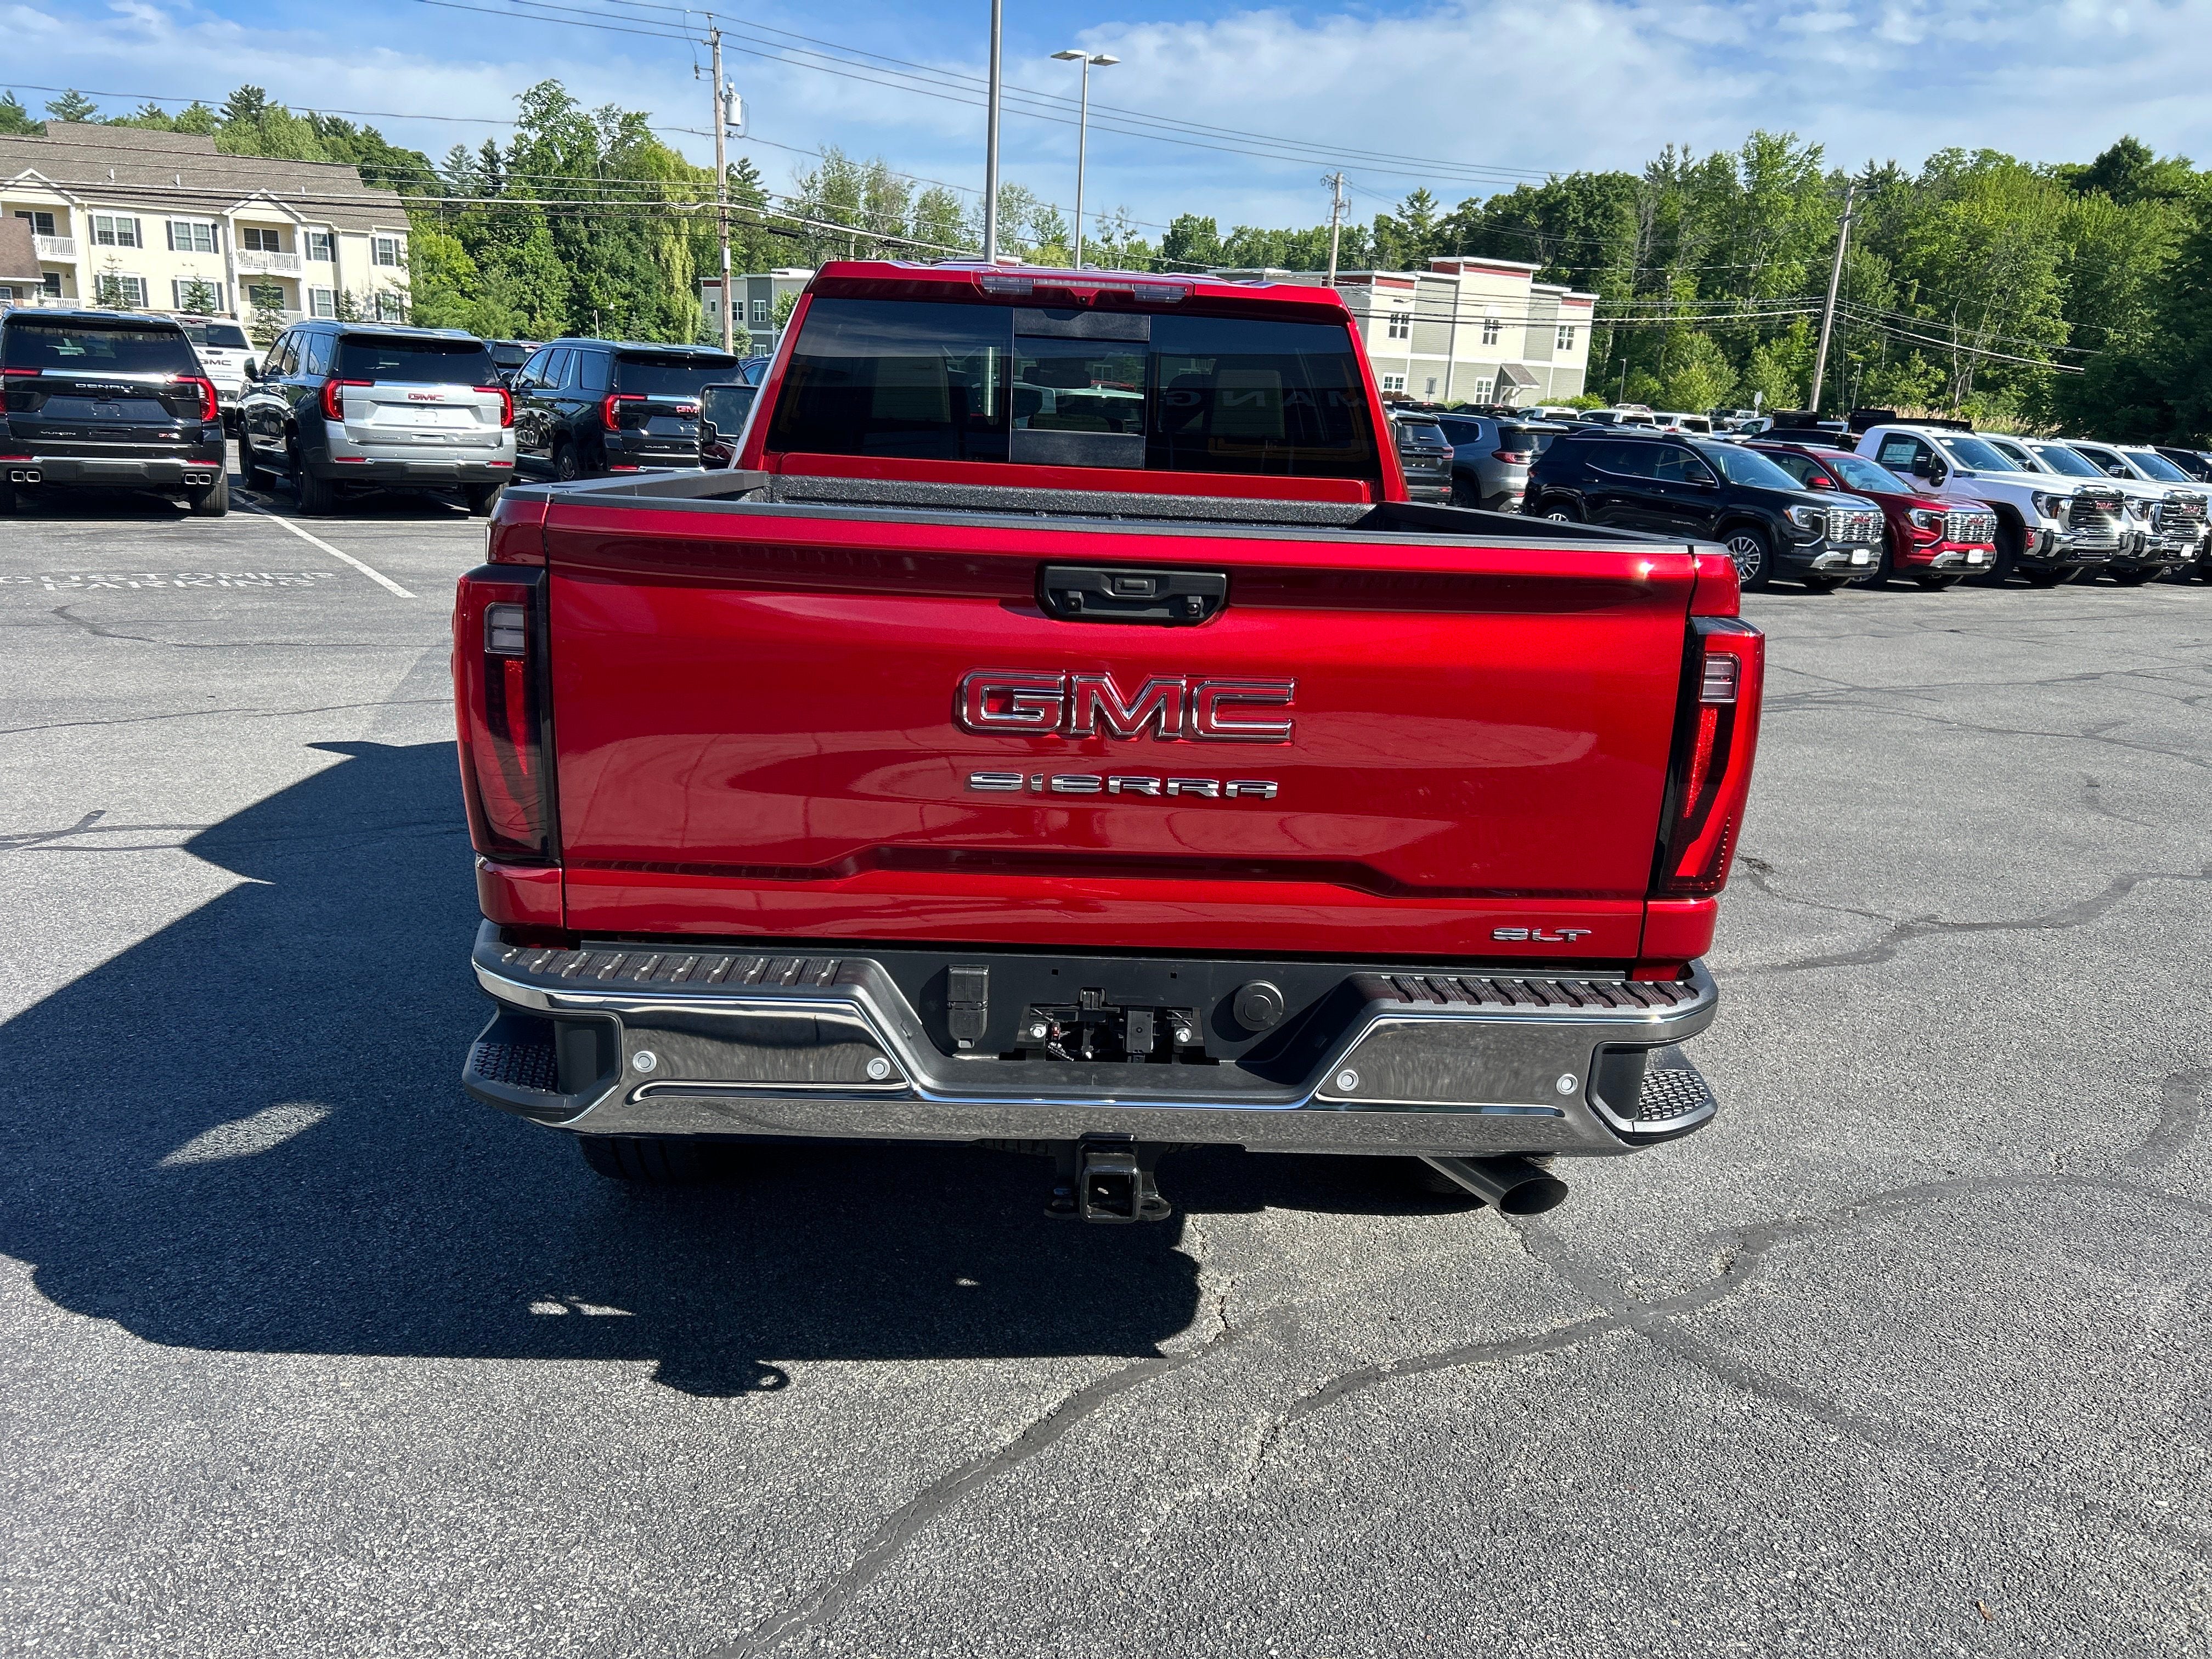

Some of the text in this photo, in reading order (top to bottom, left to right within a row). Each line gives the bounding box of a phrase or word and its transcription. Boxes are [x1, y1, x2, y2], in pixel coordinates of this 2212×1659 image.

[408, 393, 445, 402] GMC
[676, 405, 700, 414] GM
[961, 668, 1296, 740] GMC
[970, 771, 1278, 799] SIERRA
[1493, 927, 1592, 942] SLT
